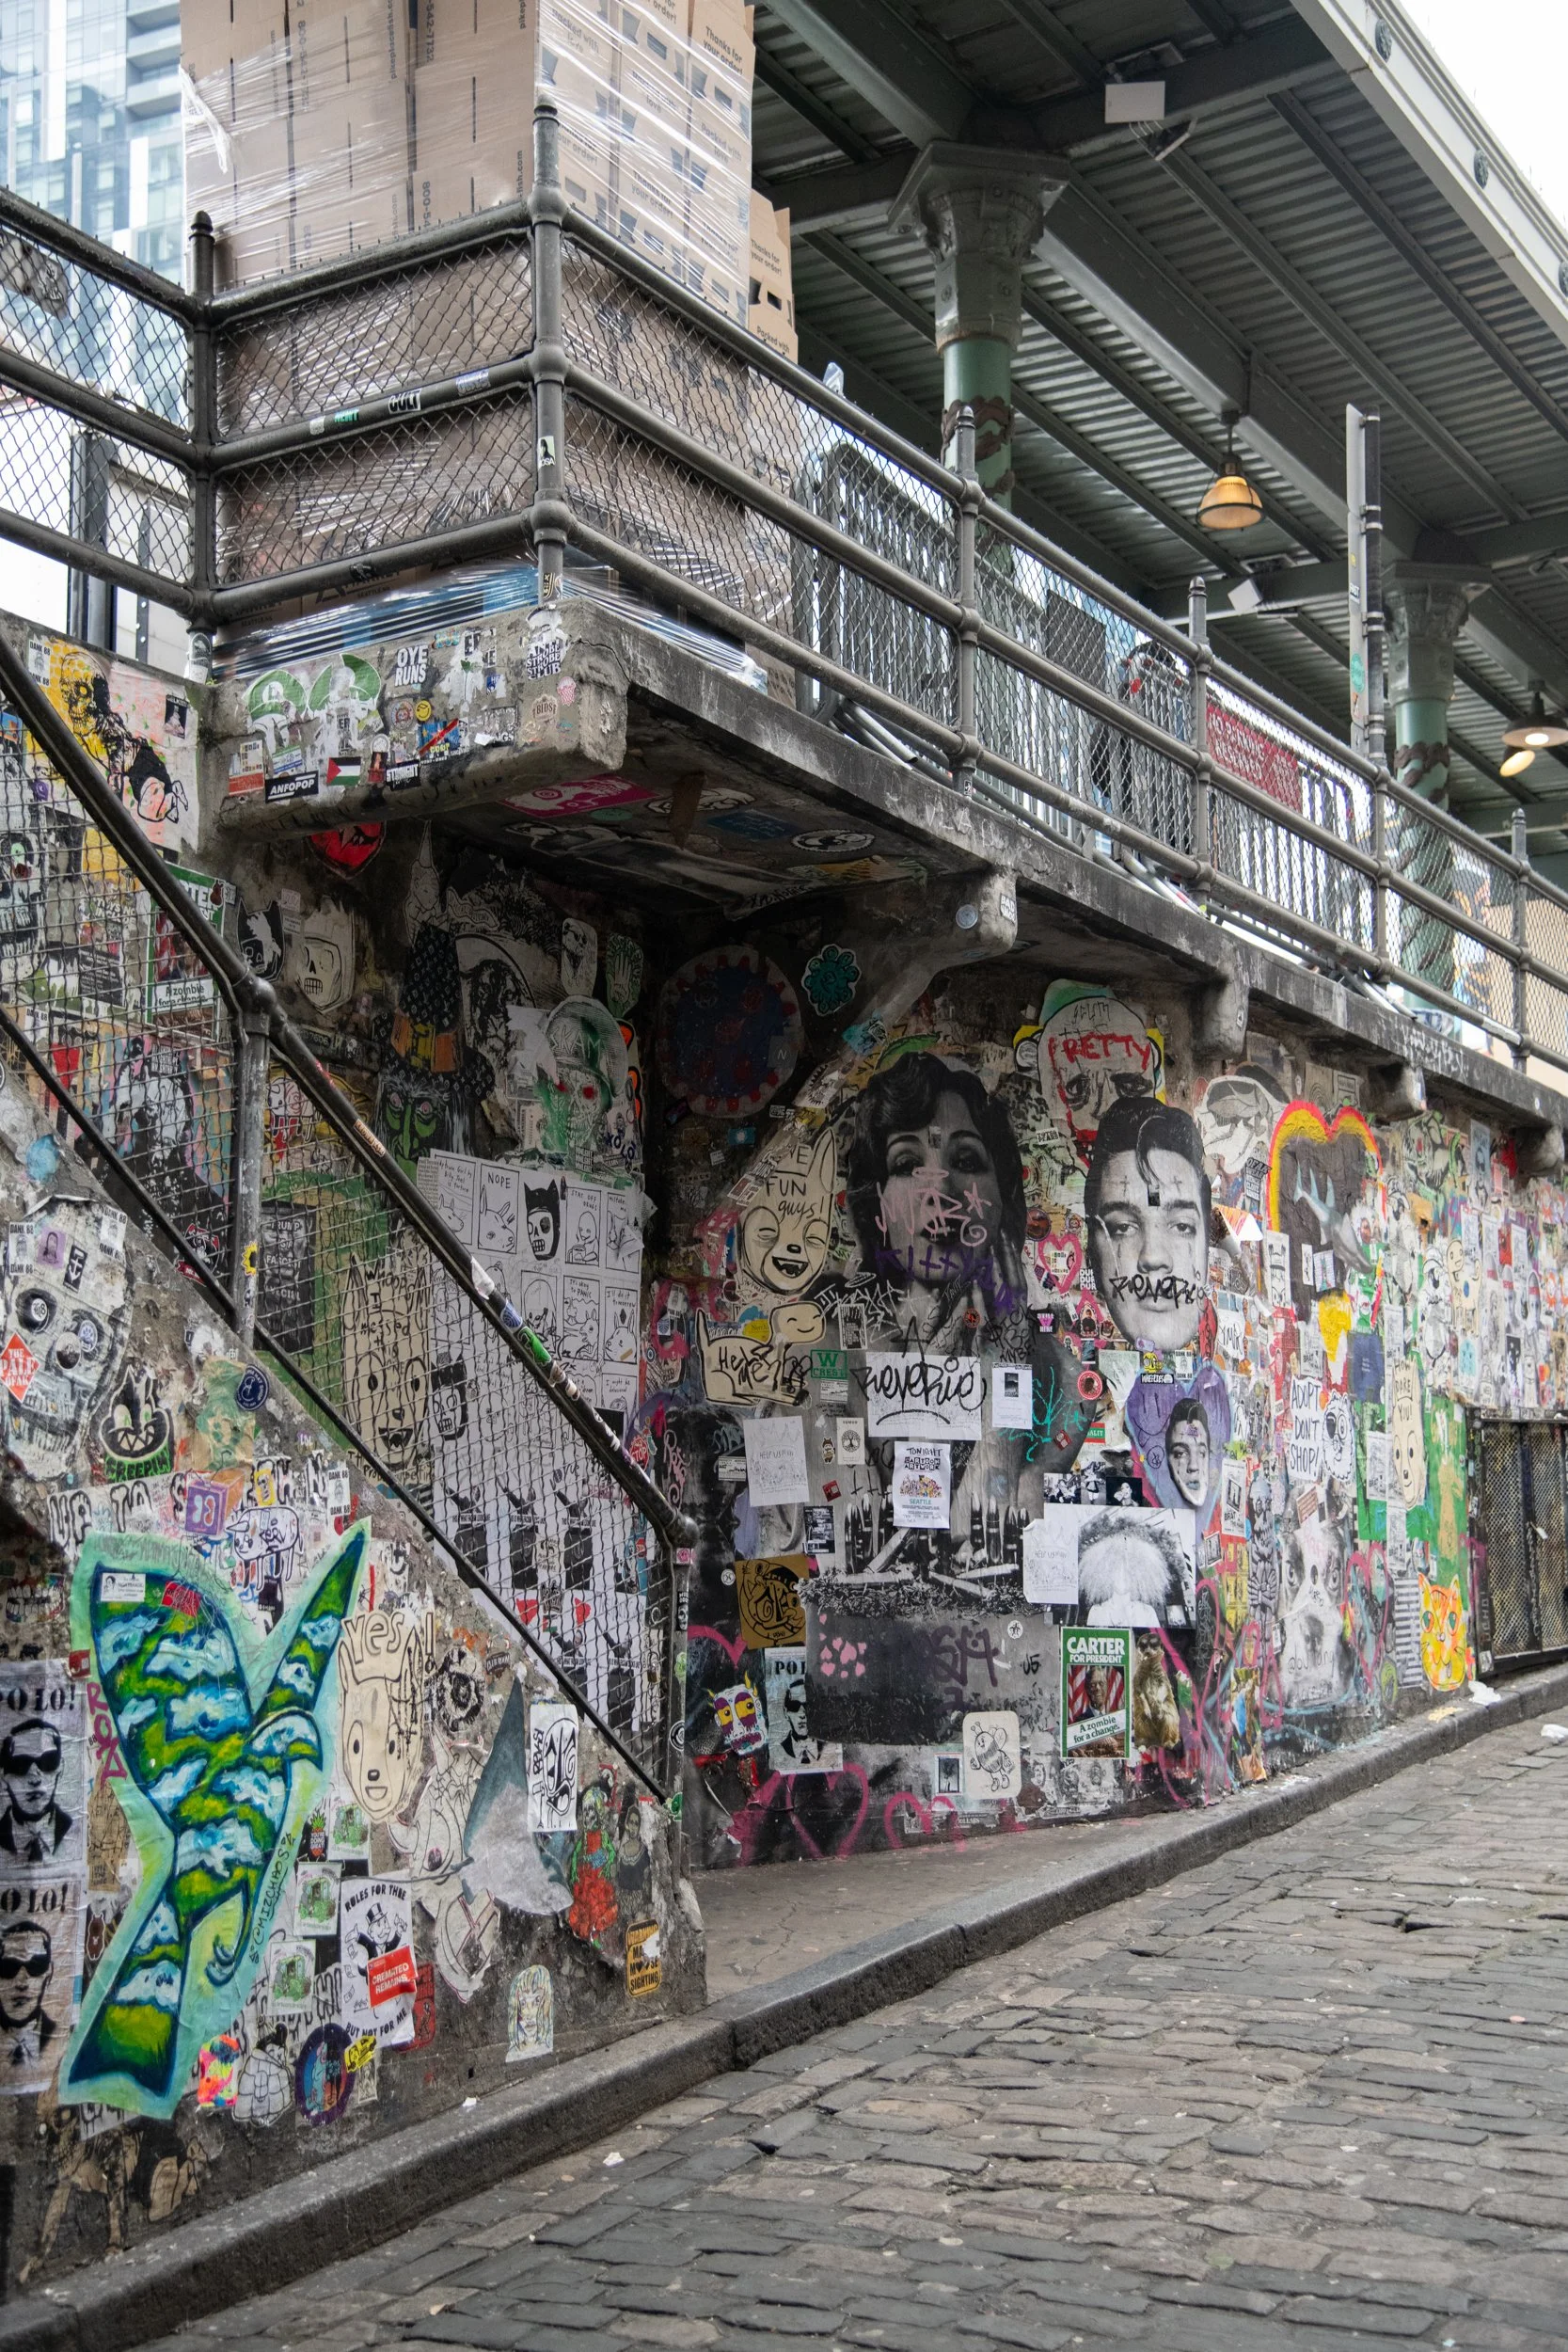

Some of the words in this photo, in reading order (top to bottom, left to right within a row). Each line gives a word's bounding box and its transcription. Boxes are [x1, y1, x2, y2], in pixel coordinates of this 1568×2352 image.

[705, 26, 731, 56] Thanks
[732, 49, 743, 62] for
[704, 40, 721, 58] your
[721, 52, 743, 75] order!
[771, 252, 781, 264] for
[29, 640, 43, 655] DANK
[43, 646, 51, 657] 88
[397, 645, 429, 667] OYE
[42, 678, 50, 688] 88
[394, 664, 427, 687] RUNS
[270, 779, 315, 796] ANFOPOP
[488, 1172, 511, 1190] NOPE
[767, 1175, 807, 1198] FUN
[119, 1212, 128, 1225] 88
[9, 1224, 24, 1234] DANK
[816, 1352, 839, 1368] W
[1291, 1380, 1322, 1410] ADOPT
[1294, 1421, 1321, 1441] DON'T
[1291, 1447, 1320, 1477] SHOP!
[329, 1470, 341, 1480] DANK
[341, 1470, 349, 1480] 88
[1067, 1636, 1126, 1656] CARTER
[1069, 1655, 1085, 1663] FOR
[1086, 1655, 1123, 1663] PRESIDENT
[1086, 1716, 1117, 1731] zombie
[1073, 1734, 1085, 1744] for
[1091, 1724, 1120, 1739] change.
[344, 1890, 370, 1913] RULES
[371, 1884, 387, 1897] FOR
[372, 1962, 410, 1986] CREMATED
[630, 1971, 658, 1992] SIGHTING
[345, 2022, 359, 2039] BUT
[379, 2022, 396, 2038] FOR
[396, 2007, 407, 2025] ME
